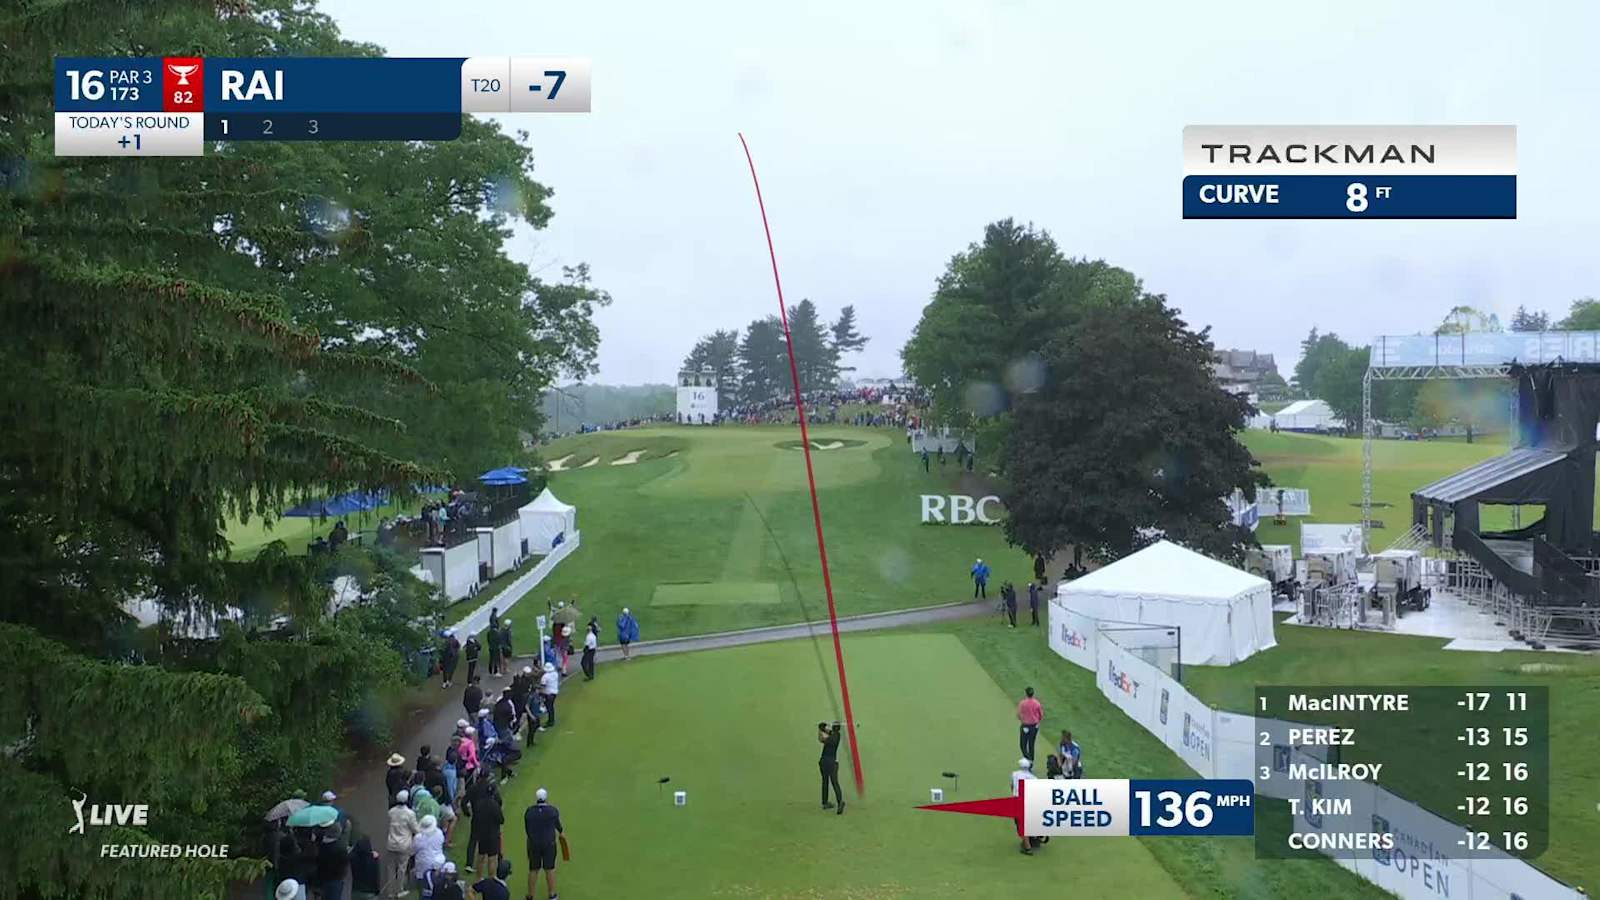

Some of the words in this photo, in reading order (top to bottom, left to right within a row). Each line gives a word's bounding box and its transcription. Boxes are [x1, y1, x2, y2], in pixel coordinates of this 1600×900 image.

[920, 494, 1001, 524] RBC
[1109, 659, 1132, 696] FedEx
[1393, 848, 1450, 898] OPEN
